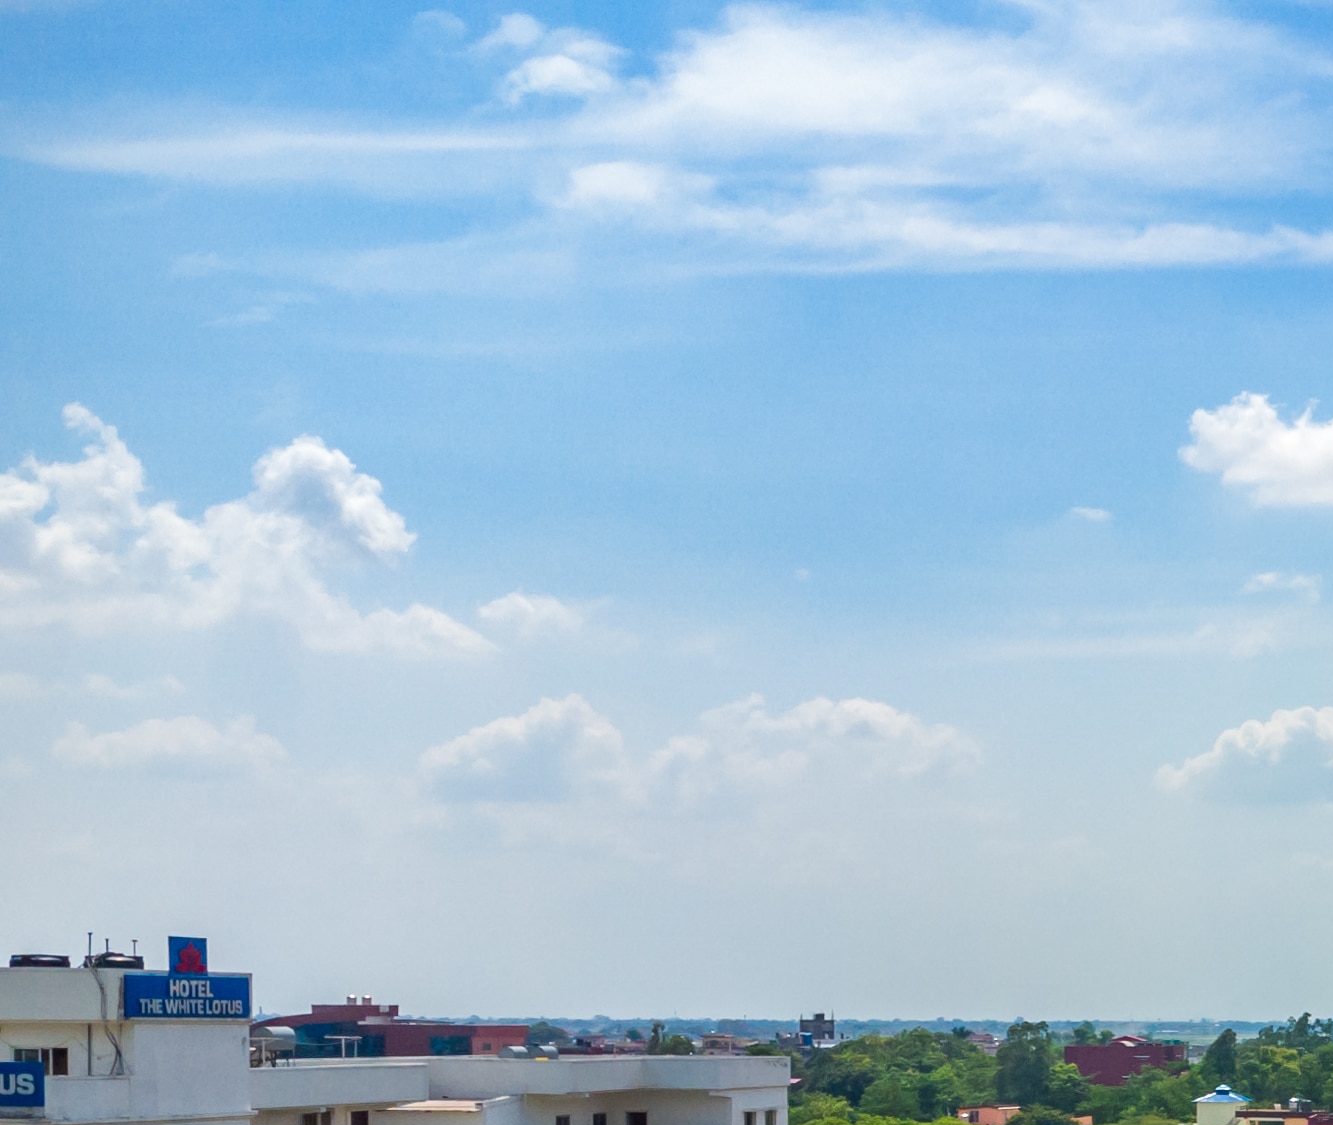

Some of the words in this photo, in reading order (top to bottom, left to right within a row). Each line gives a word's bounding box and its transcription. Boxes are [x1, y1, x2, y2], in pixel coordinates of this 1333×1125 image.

[169, 979, 213, 998] HOTEL
[140, 999, 163, 1014] THE
[165, 1000, 205, 1014] WHITE
[206, 1000, 243, 1015] LOTUS
[0, 1073, 35, 1095] US
